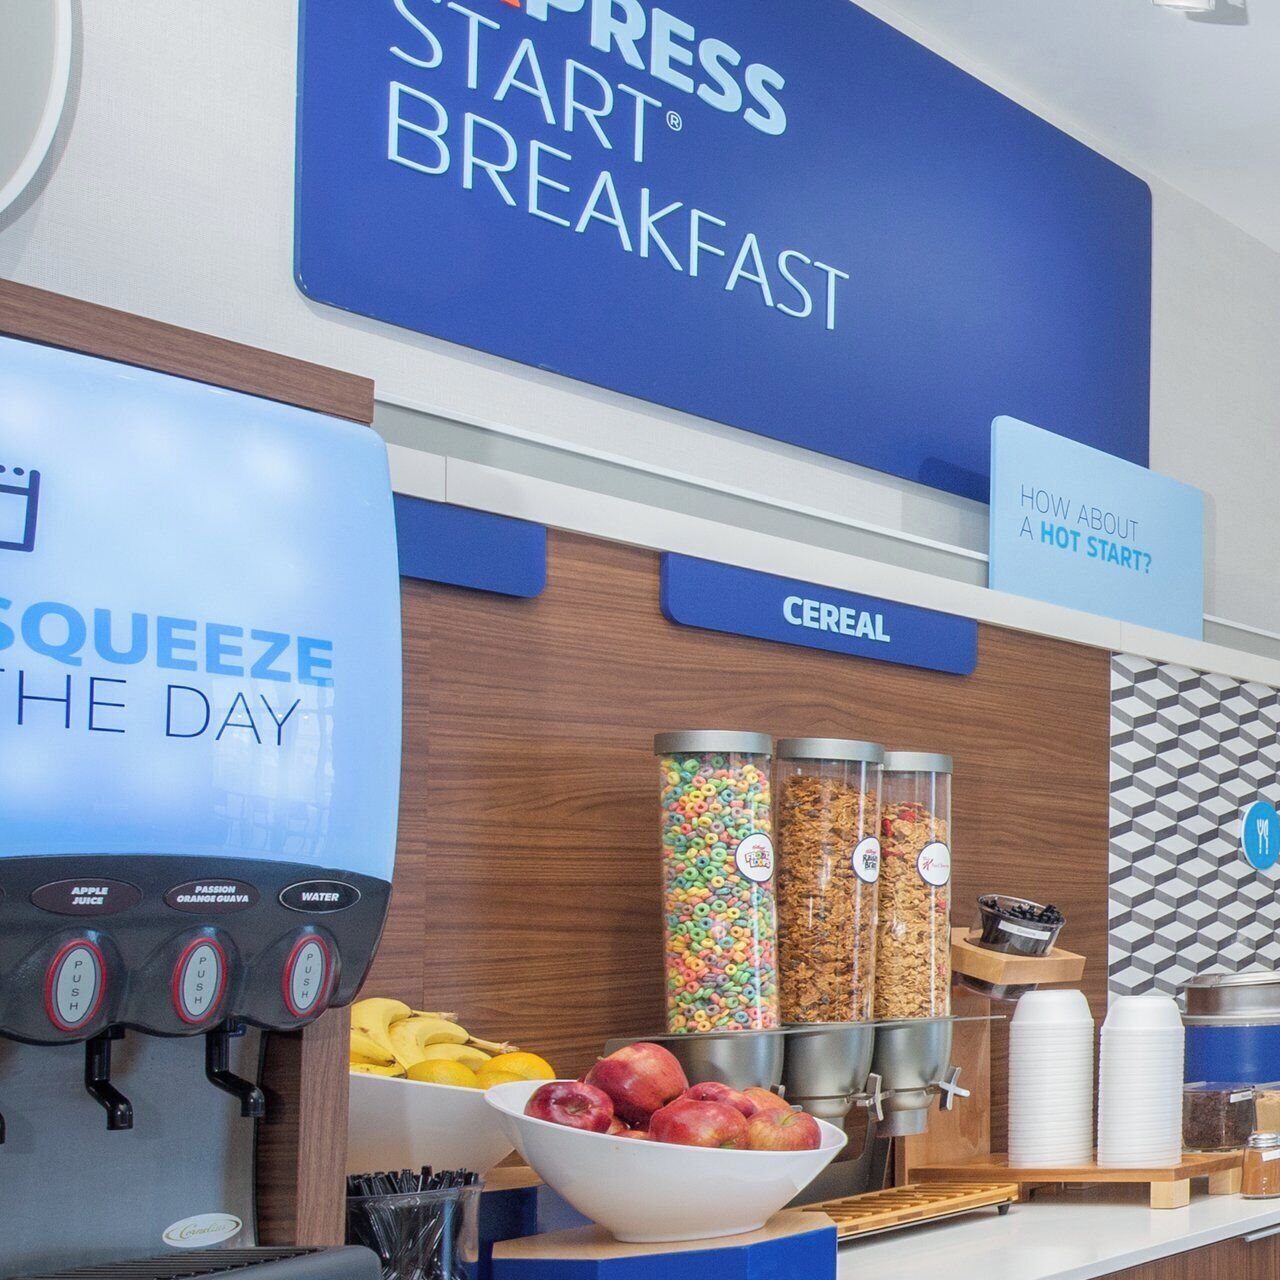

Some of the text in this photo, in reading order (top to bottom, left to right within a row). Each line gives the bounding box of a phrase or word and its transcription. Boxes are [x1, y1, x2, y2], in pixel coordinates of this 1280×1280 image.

[502, 0, 787, 135] RESS
[388, 81, 850, 330] BREAKFAST
[1021, 484, 1139, 541] HOW ABOUT
[1019, 516, 1152, 573] A HOT START?
[782, 595, 891, 643] CEREAL
[0, 668, 301, 747] HE DAY
[71, 887, 109, 895] APPLE
[72, 897, 104, 905] JUICE
[176, 895, 249, 903] ORANGE GUAVA
[195, 885, 236, 894] PASSION
[301, 892, 340, 902] WATER
[69, 960, 83, 1011] PUSH
[194, 957, 207, 1005] PUSH
[301, 953, 314, 999] PUSH
